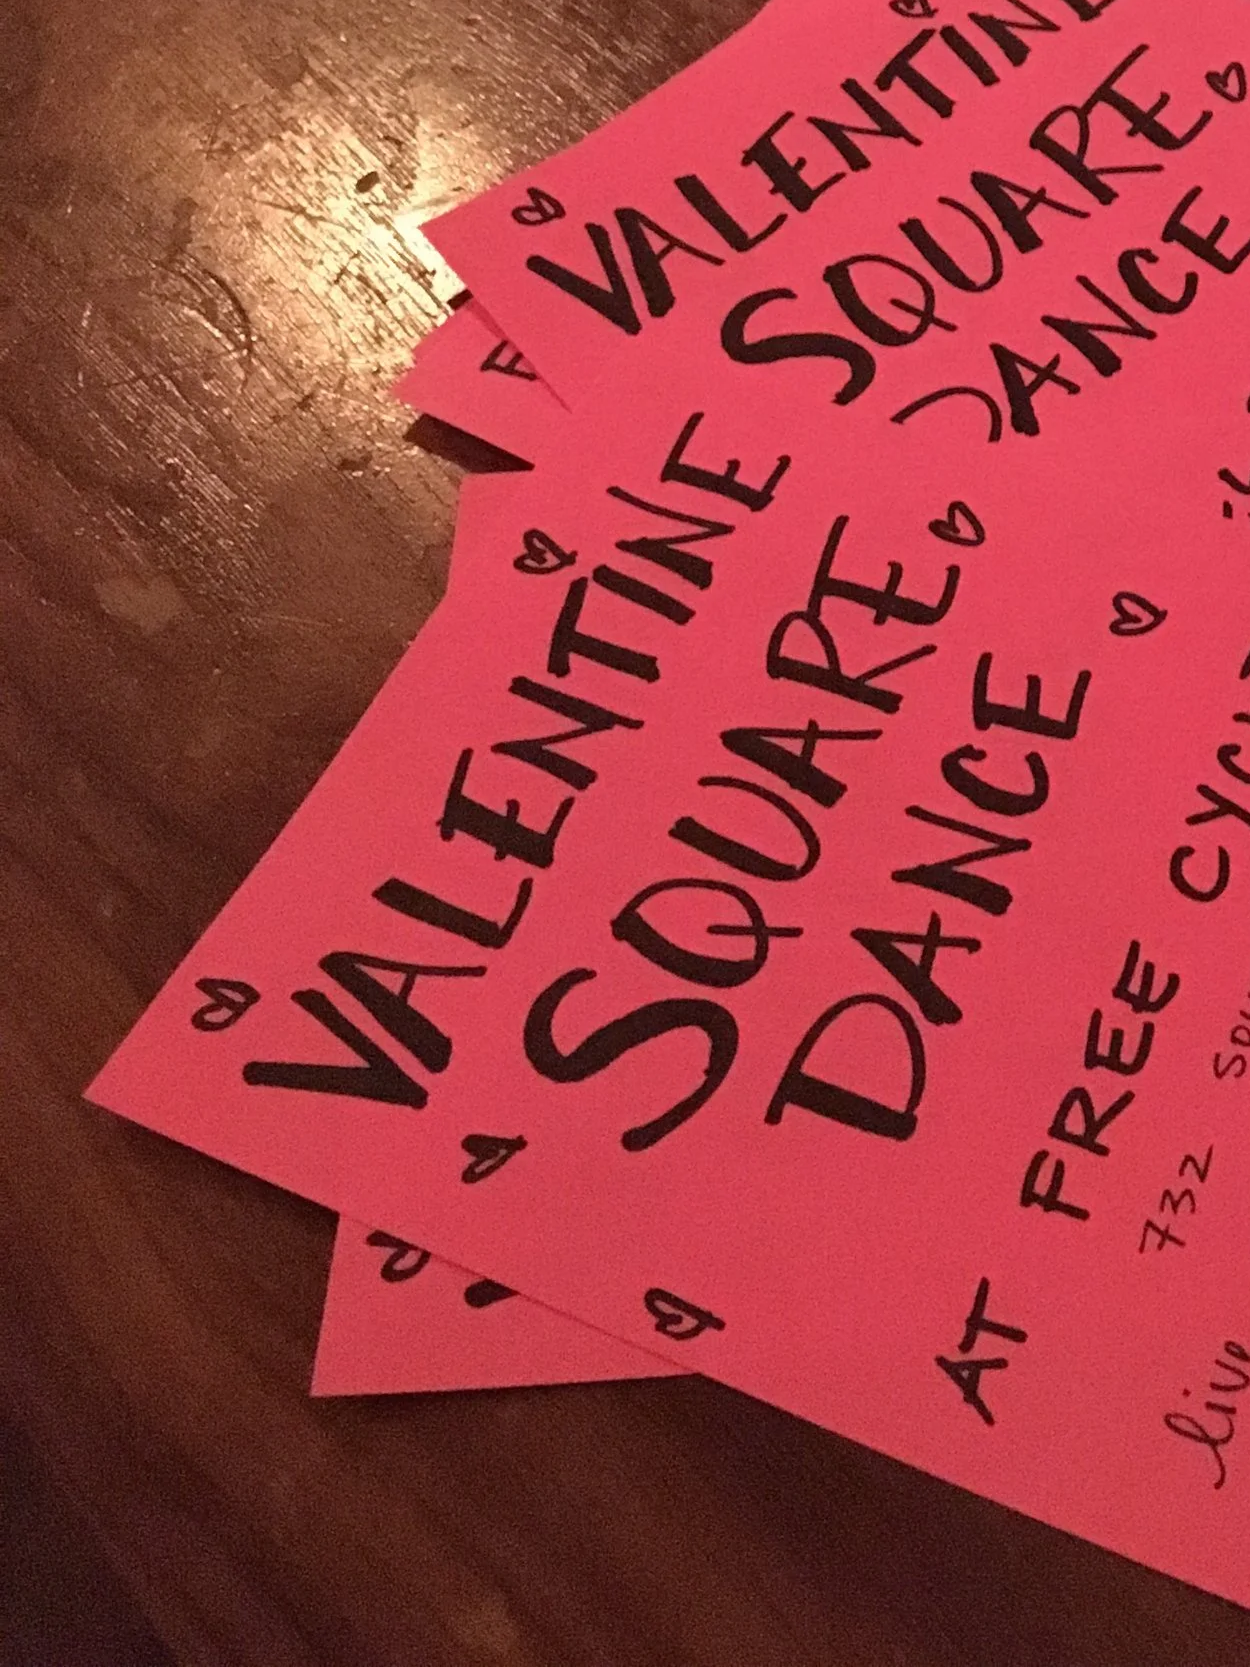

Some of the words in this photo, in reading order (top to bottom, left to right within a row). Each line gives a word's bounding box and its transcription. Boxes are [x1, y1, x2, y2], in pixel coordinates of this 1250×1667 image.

[720, 43, 1213, 406] SQUARE
[242, 411, 792, 1110] VALENTINE
[522, 514, 961, 1152] SQUARE
[764, 651, 1093, 1142] DANCE
[934, 1276, 1029, 1427] AT
[1019, 938, 1182, 1222] FREE
[1138, 1143, 1214, 1254] 732
